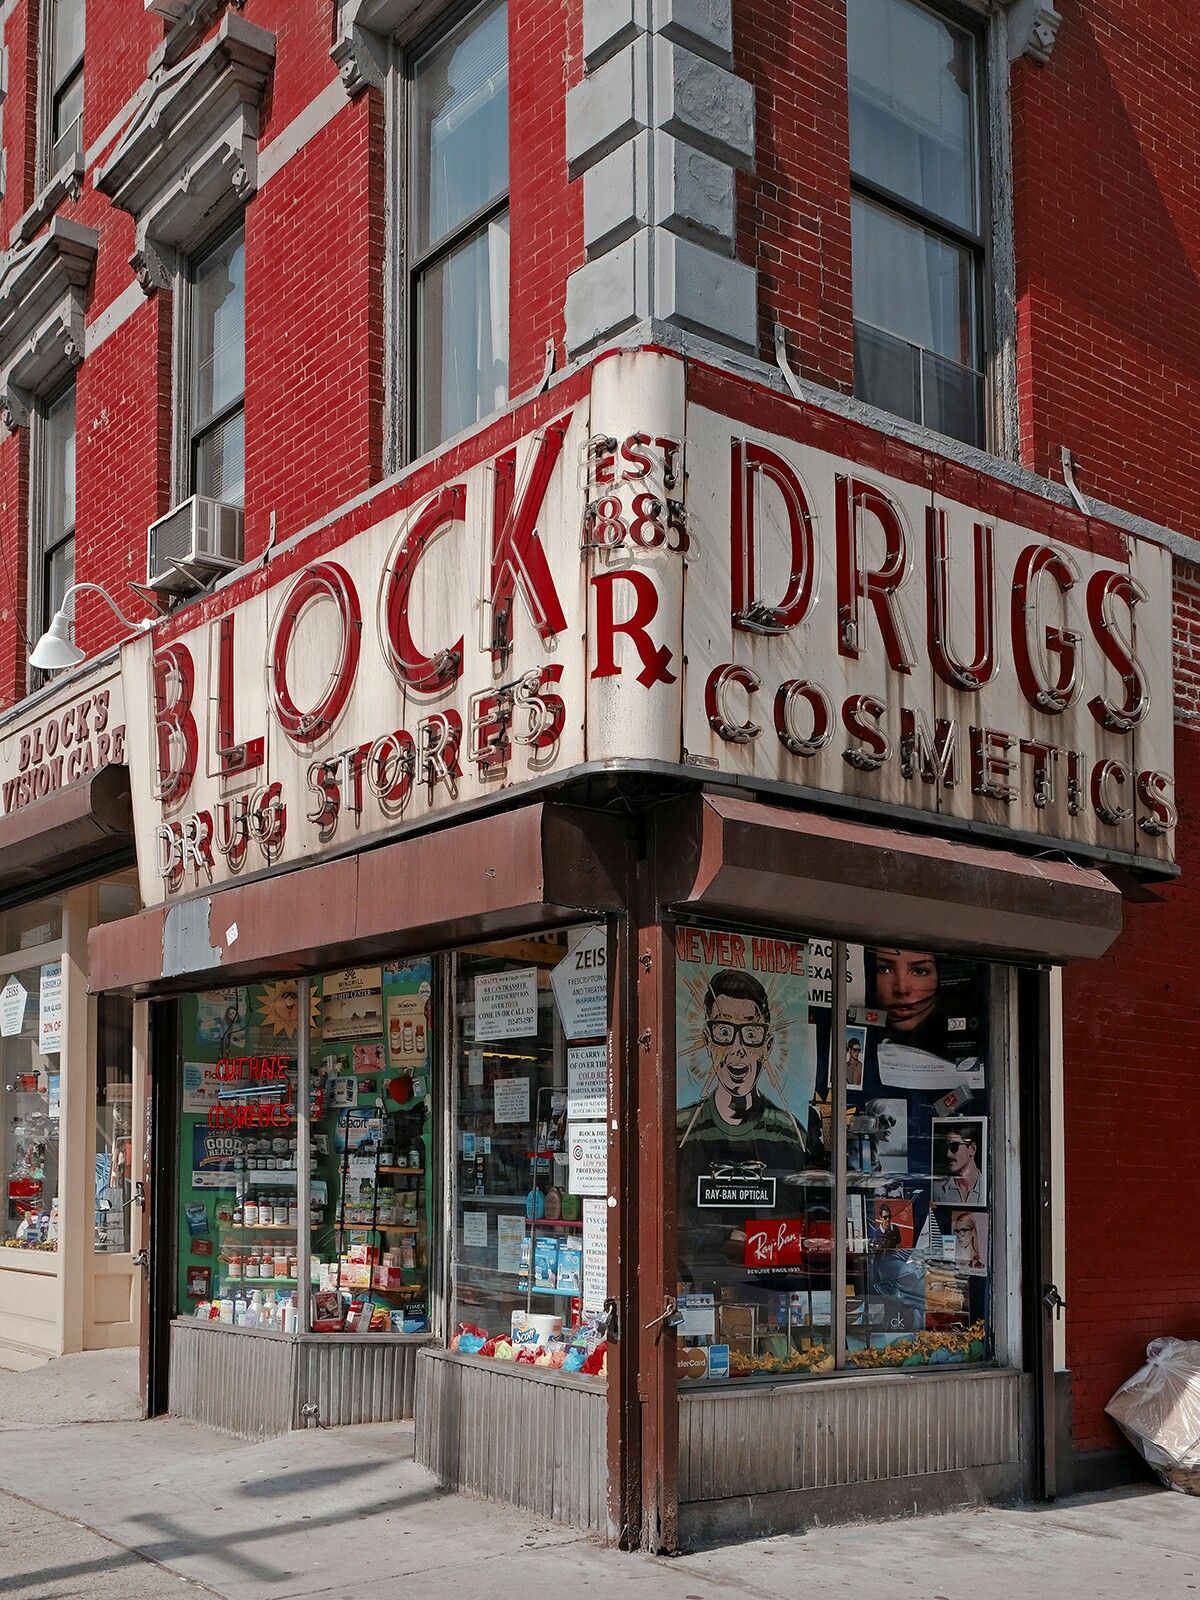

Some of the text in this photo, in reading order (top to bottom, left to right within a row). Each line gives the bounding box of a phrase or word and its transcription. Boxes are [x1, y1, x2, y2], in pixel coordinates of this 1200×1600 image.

[579, 432, 684, 487] EST
[147, 412, 573, 803] BLOCK
[731, 436, 1151, 734] DRUGS
[2, 724, 125, 813] VISION CARE
[19, 690, 110, 771] BLOCK'S
[704, 663, 1178, 837] COSMETICS
[156, 664, 568, 880] DRUG STORES
[676, 927, 804, 976] NEVER HIDE
[248, 1055, 290, 1080] RATE
[578, 1072, 596, 1080] COLD
[705, 1189, 769, 1200] RAY-BAN OPTICAL
